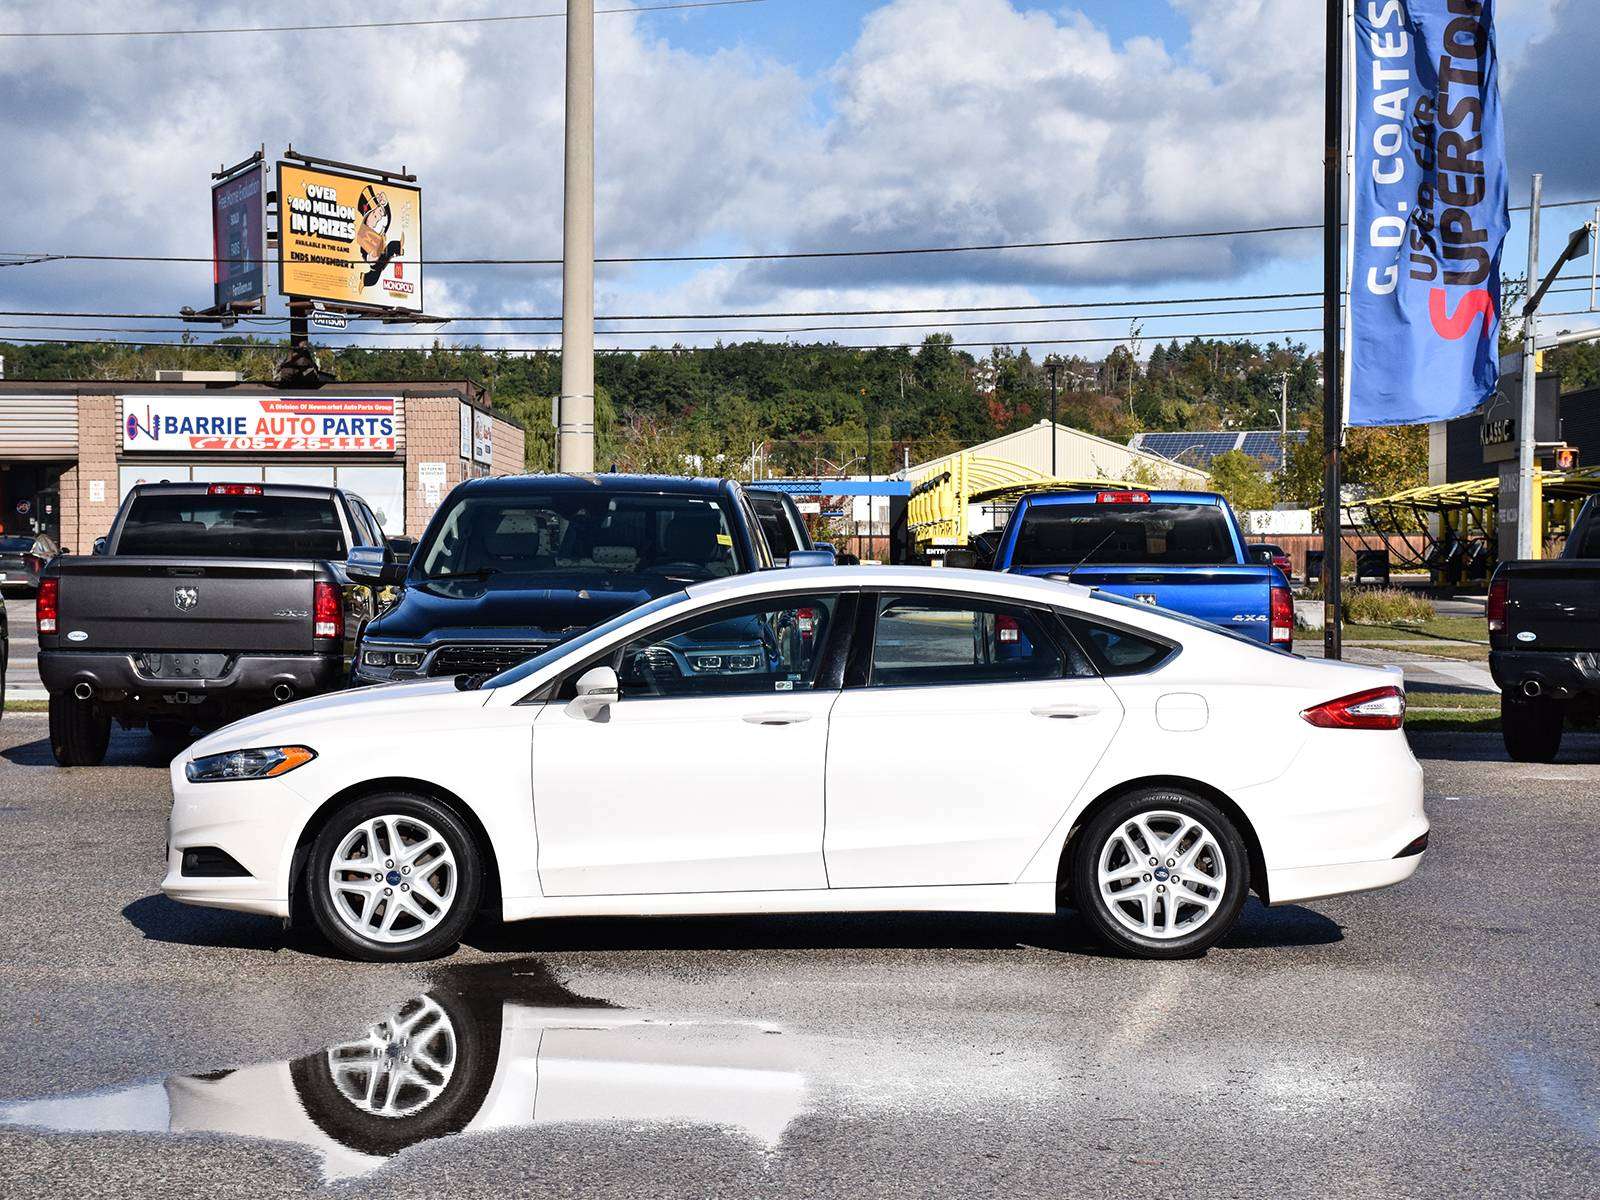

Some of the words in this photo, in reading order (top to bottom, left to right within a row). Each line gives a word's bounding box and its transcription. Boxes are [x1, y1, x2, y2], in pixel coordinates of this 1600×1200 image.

[1368, 0, 1410, 185] COATES
[1411, 94, 1438, 172] CAR
[306, 184, 337, 202] OVER
[312, 200, 356, 220] MILLION
[291, 212, 308, 232] IN
[309, 216, 356, 240] PRIZES
[1410, 181, 1438, 282] USED
[295, 239, 321, 249] AVAILABLE
[336, 246, 350, 254] GAME
[290, 251, 309, 261] ENDS
[310, 253, 349, 269] NOVEMBER
[384, 280, 413, 294] MONOPOLY
[276, 403, 299, 411] Division
[165, 416, 247, 435] BARRIE
[255, 417, 316, 436] AUTO
[323, 417, 393, 436] PARTS
[222, 437, 389, 449] 705-725-1114
